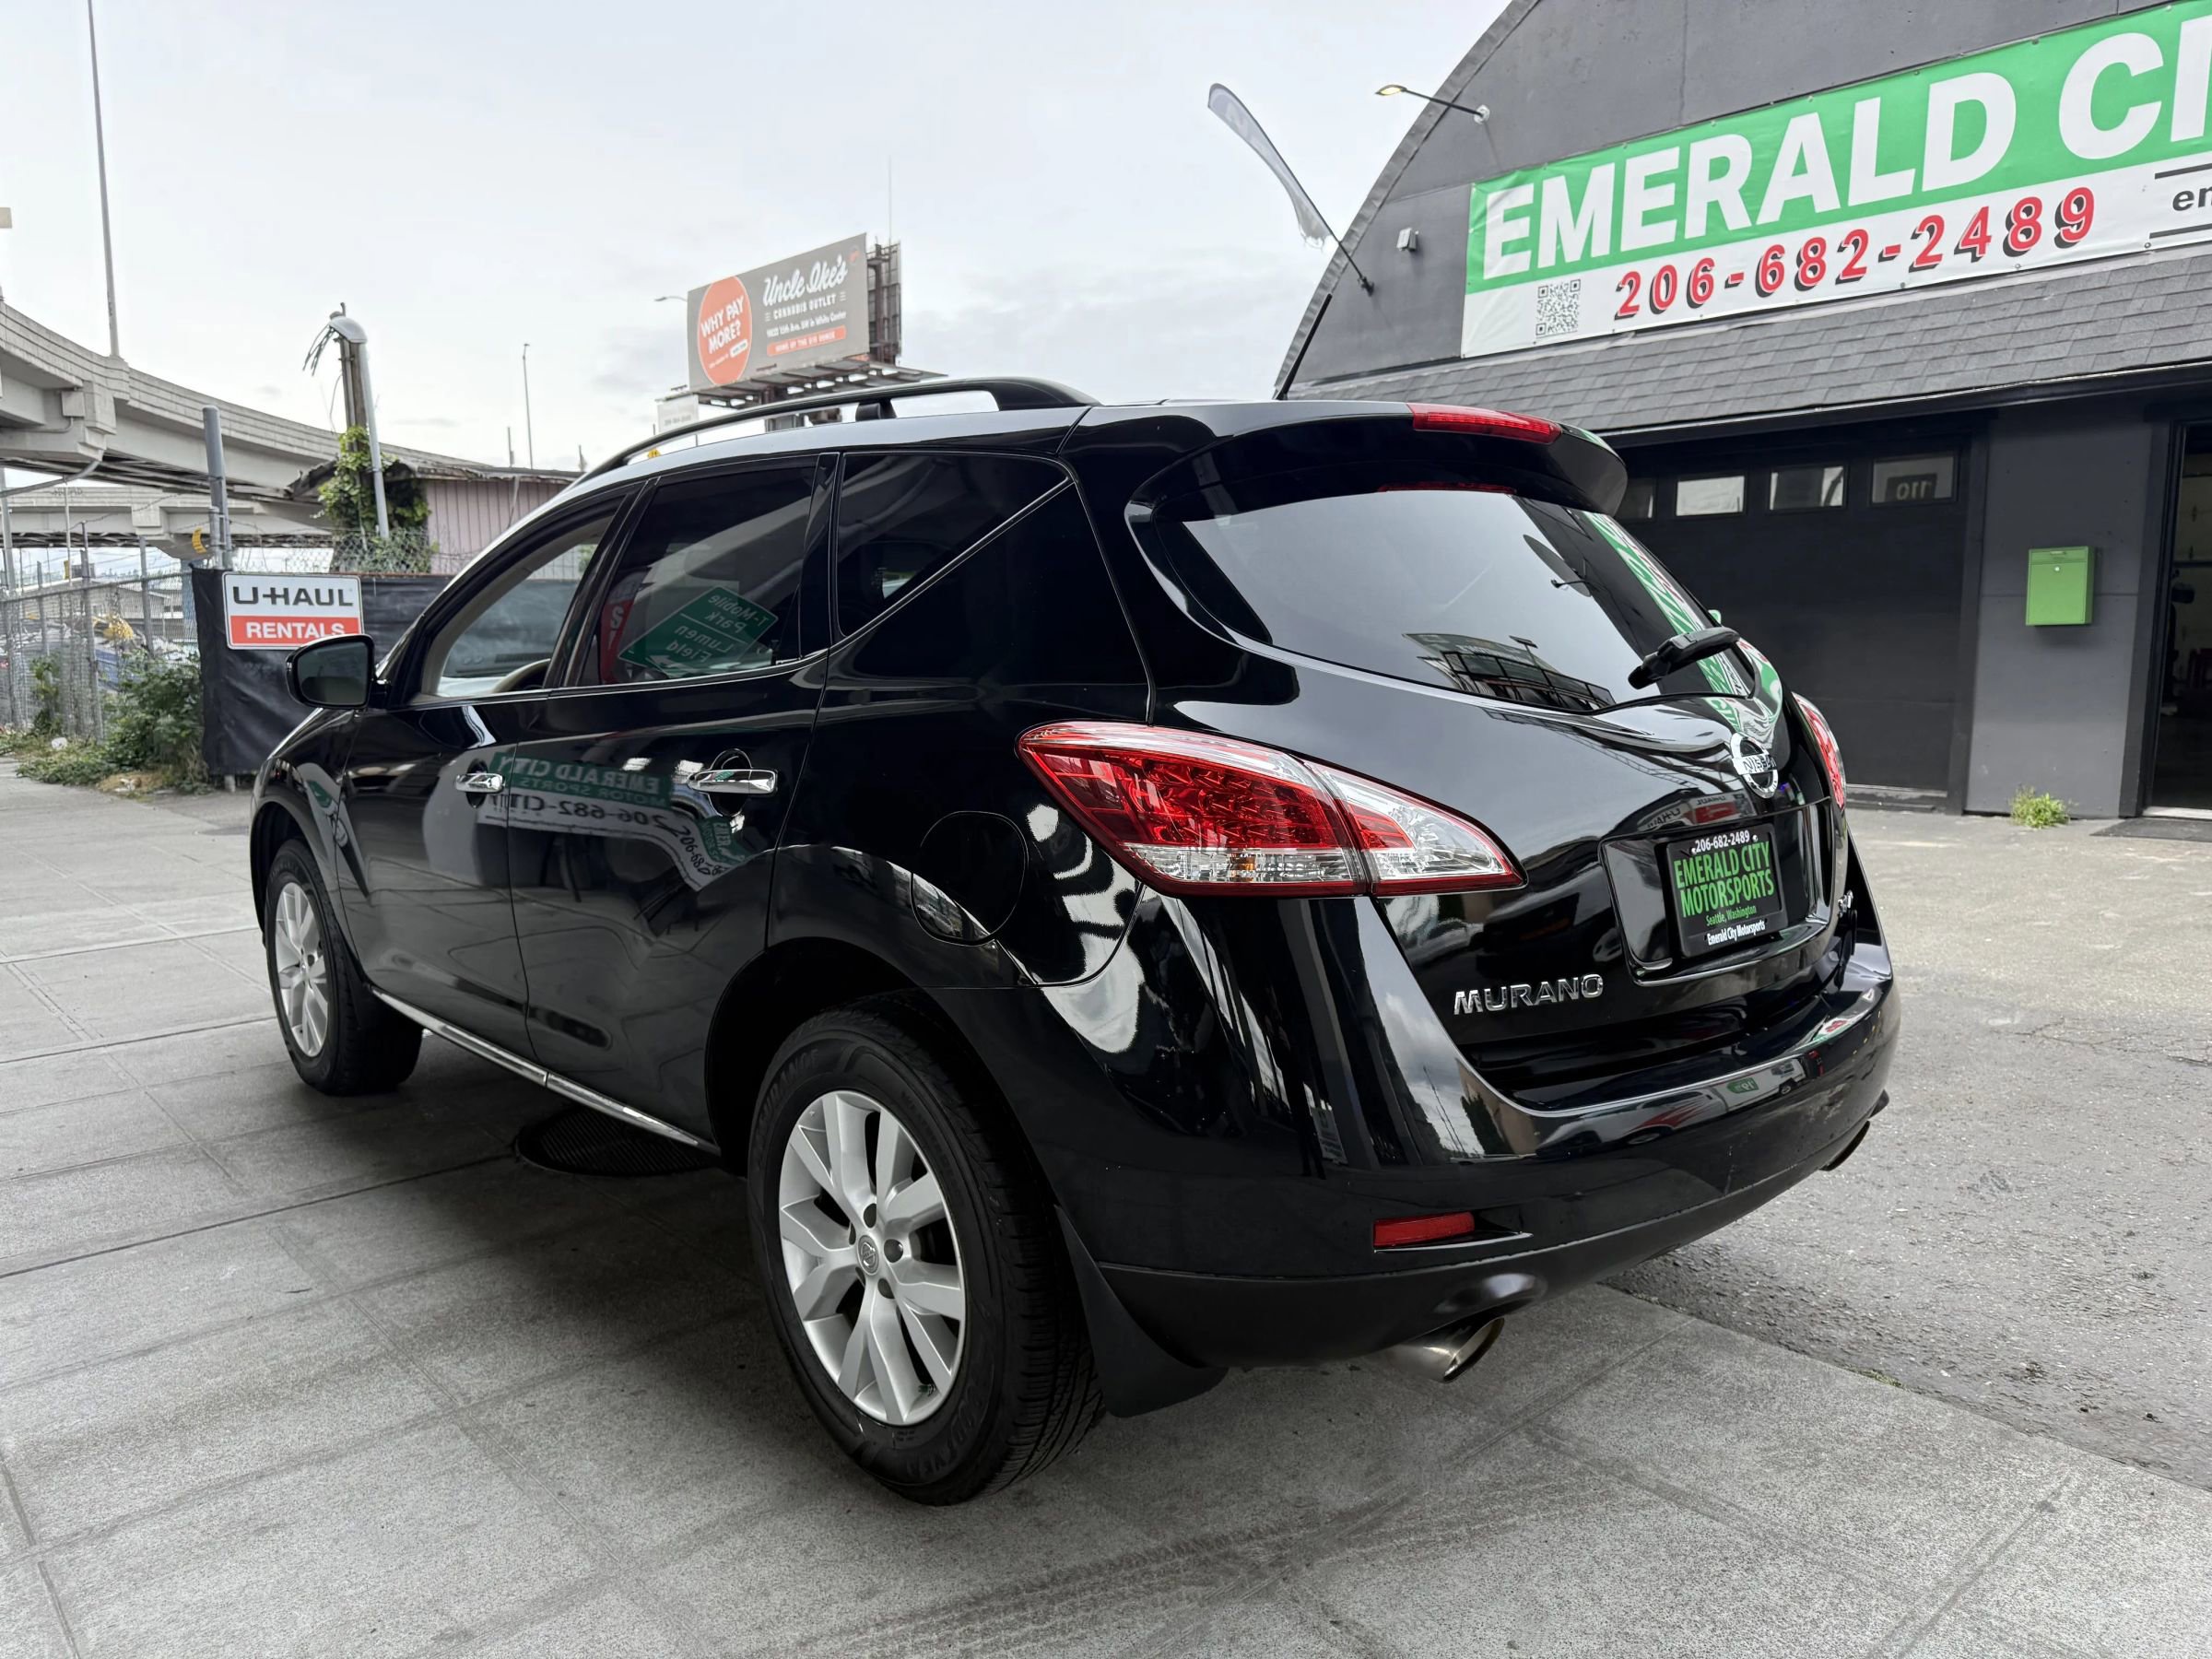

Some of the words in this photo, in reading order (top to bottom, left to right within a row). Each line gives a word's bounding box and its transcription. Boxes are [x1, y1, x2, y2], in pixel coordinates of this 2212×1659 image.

[1483, 73, 2018, 279] EMERALD
[2058, 14, 2212, 159] CI
[1615, 187, 2095, 318] 206-682-2489
[762, 268, 806, 307] Uncle
[806, 253, 848, 293] Ike's
[700, 310, 724, 338] WHY
[726, 295, 745, 320] PAY
[808, 293, 837, 312] OUTLET
[708, 321, 742, 354] MORE?
[232, 586, 354, 606] U-HAUL
[246, 621, 346, 640] RENTALS
[1695, 830, 1749, 853] 206-682-2489
[1674, 848, 1740, 888] EMERALD
[1741, 841, 1771, 872] CITY
[1680, 868, 1774, 918] MOTORSPORTS
[1705, 912, 1727, 926] Seattle,
[1726, 905, 1757, 921] Washington
[1707, 928, 1727, 946] Emerald
[1726, 926, 1737, 941] City
[1736, 920, 1765, 936] Motorsports
[1453, 973, 1604, 1015] MURANO
